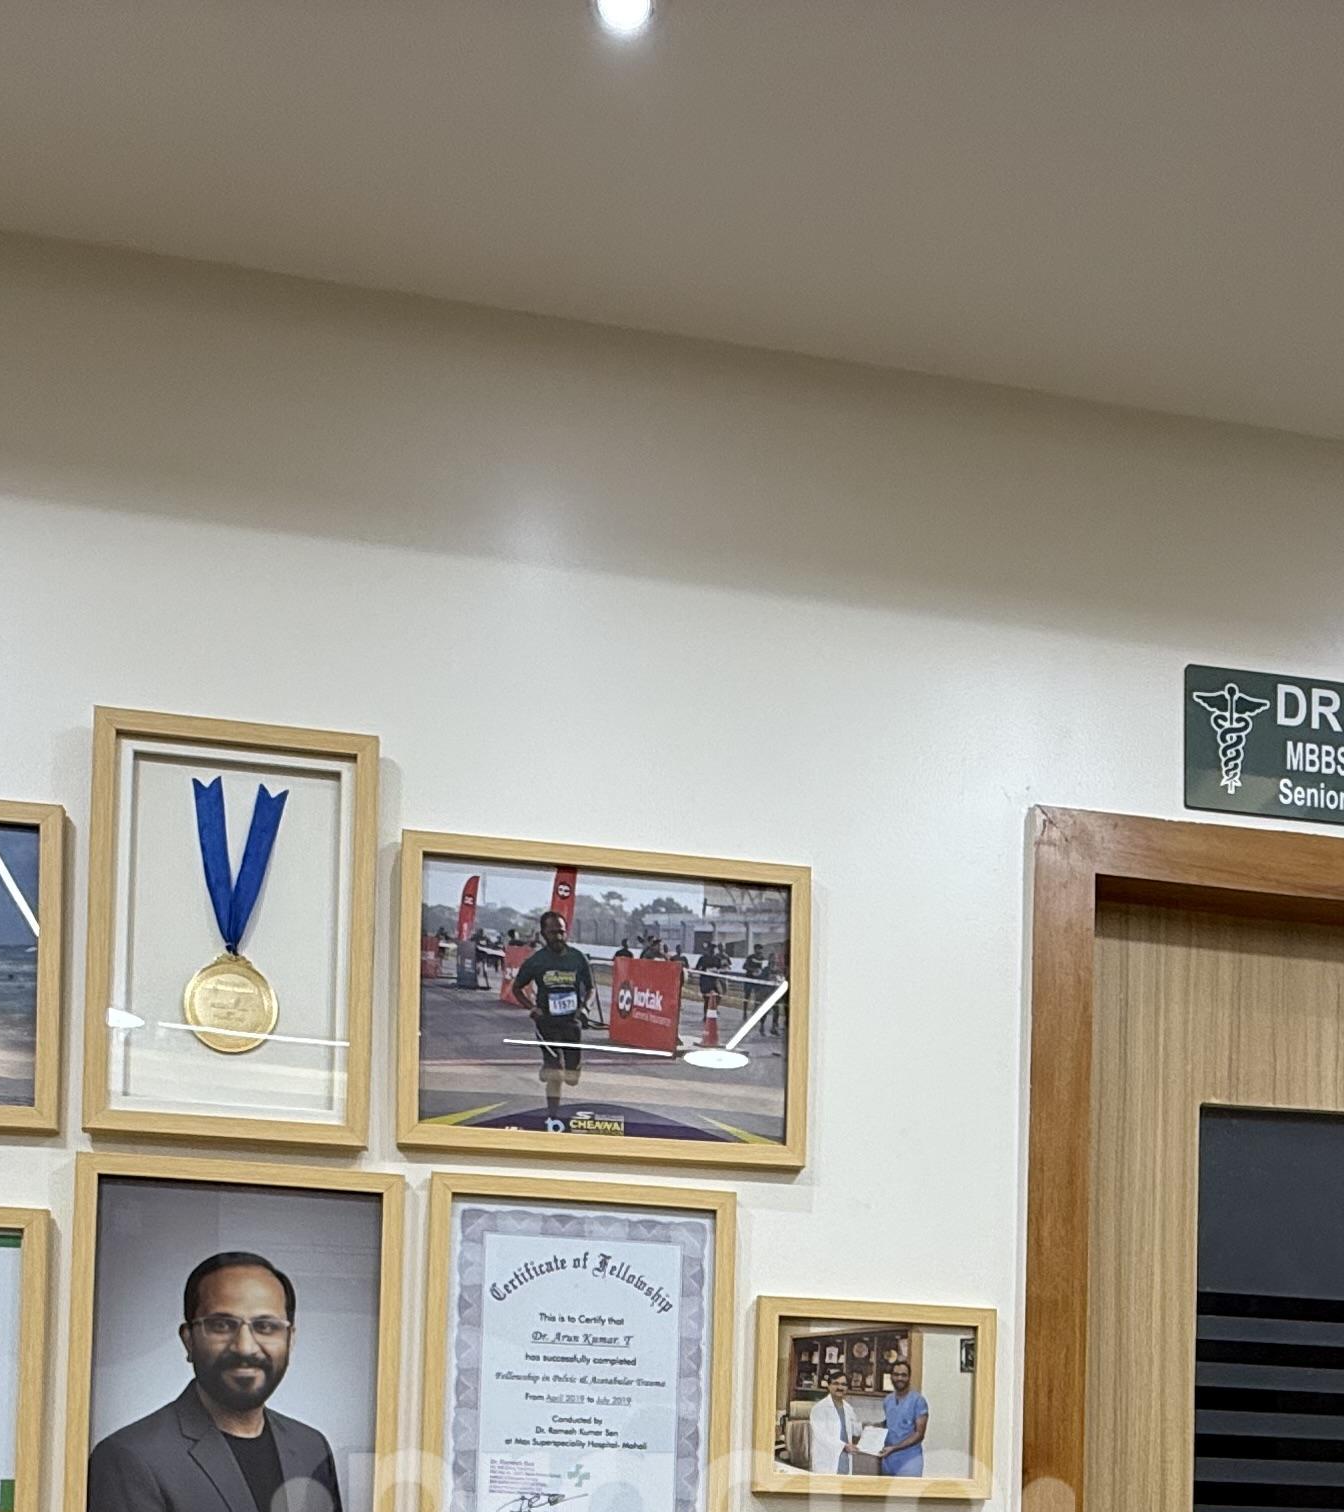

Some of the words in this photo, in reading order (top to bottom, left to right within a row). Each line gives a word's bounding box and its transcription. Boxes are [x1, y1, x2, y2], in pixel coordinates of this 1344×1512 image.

[633, 986, 663, 1011] kotak
[489, 1255, 568, 1302] Certificate
[572, 1251, 590, 1269] of
[592, 1253, 673, 1314] Fellowship
[539, 1312, 556, 1322] This
[558, 1314, 565, 1322] is
[567, 1315, 576, 1323] to
[578, 1315, 606, 1326] Certify
[608, 1316, 625, 1326] that
